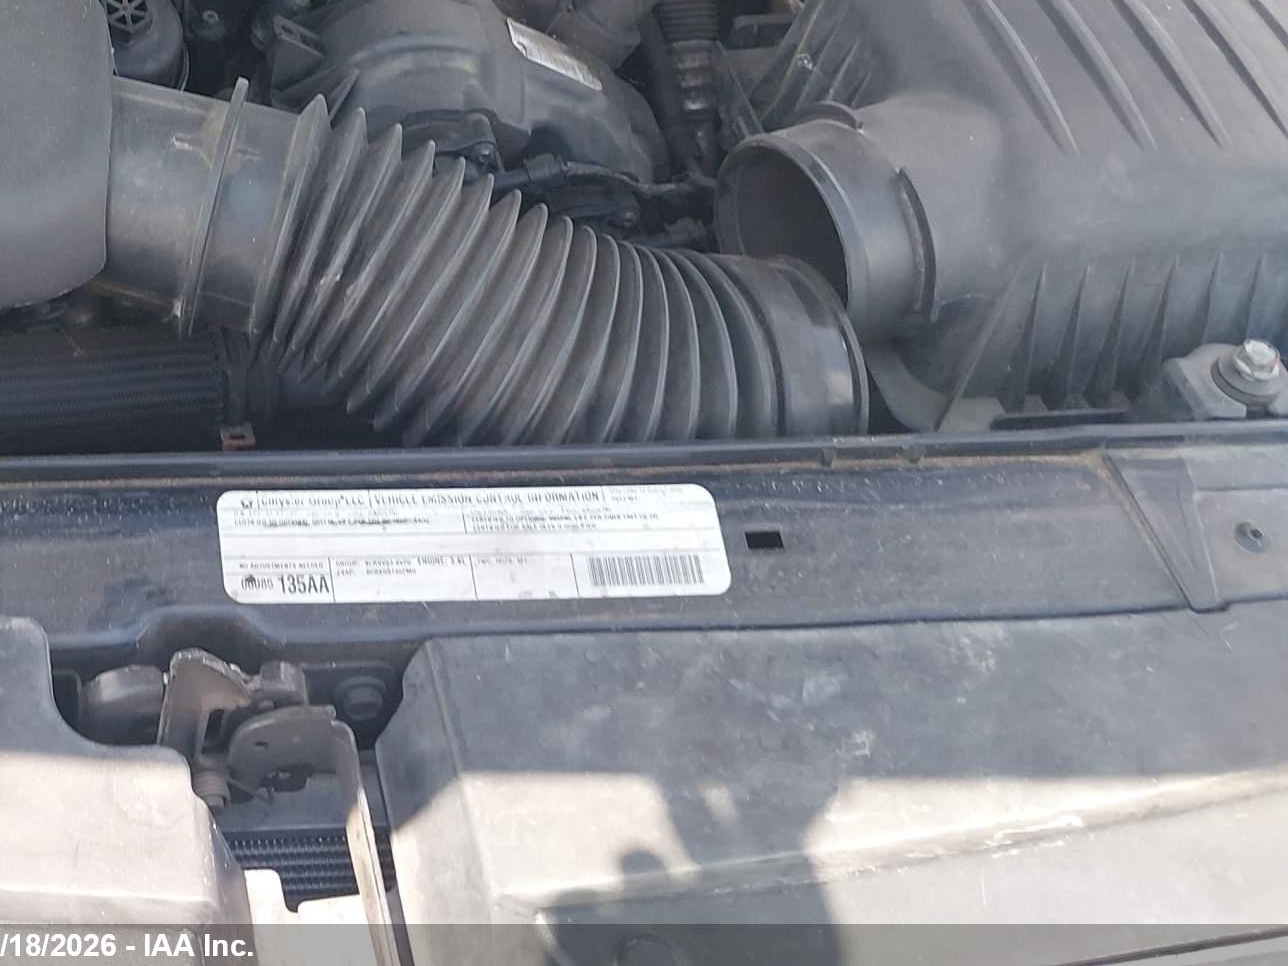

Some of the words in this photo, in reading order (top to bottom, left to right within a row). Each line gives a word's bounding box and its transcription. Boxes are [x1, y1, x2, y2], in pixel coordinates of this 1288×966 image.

[374, 493, 418, 506] VEHICLE
[421, 493, 472, 506] EMISSION
[475, 492, 522, 505] CONTROL
[527, 490, 600, 504] INFORMATION
[277, 573, 330, 594] 135AA
